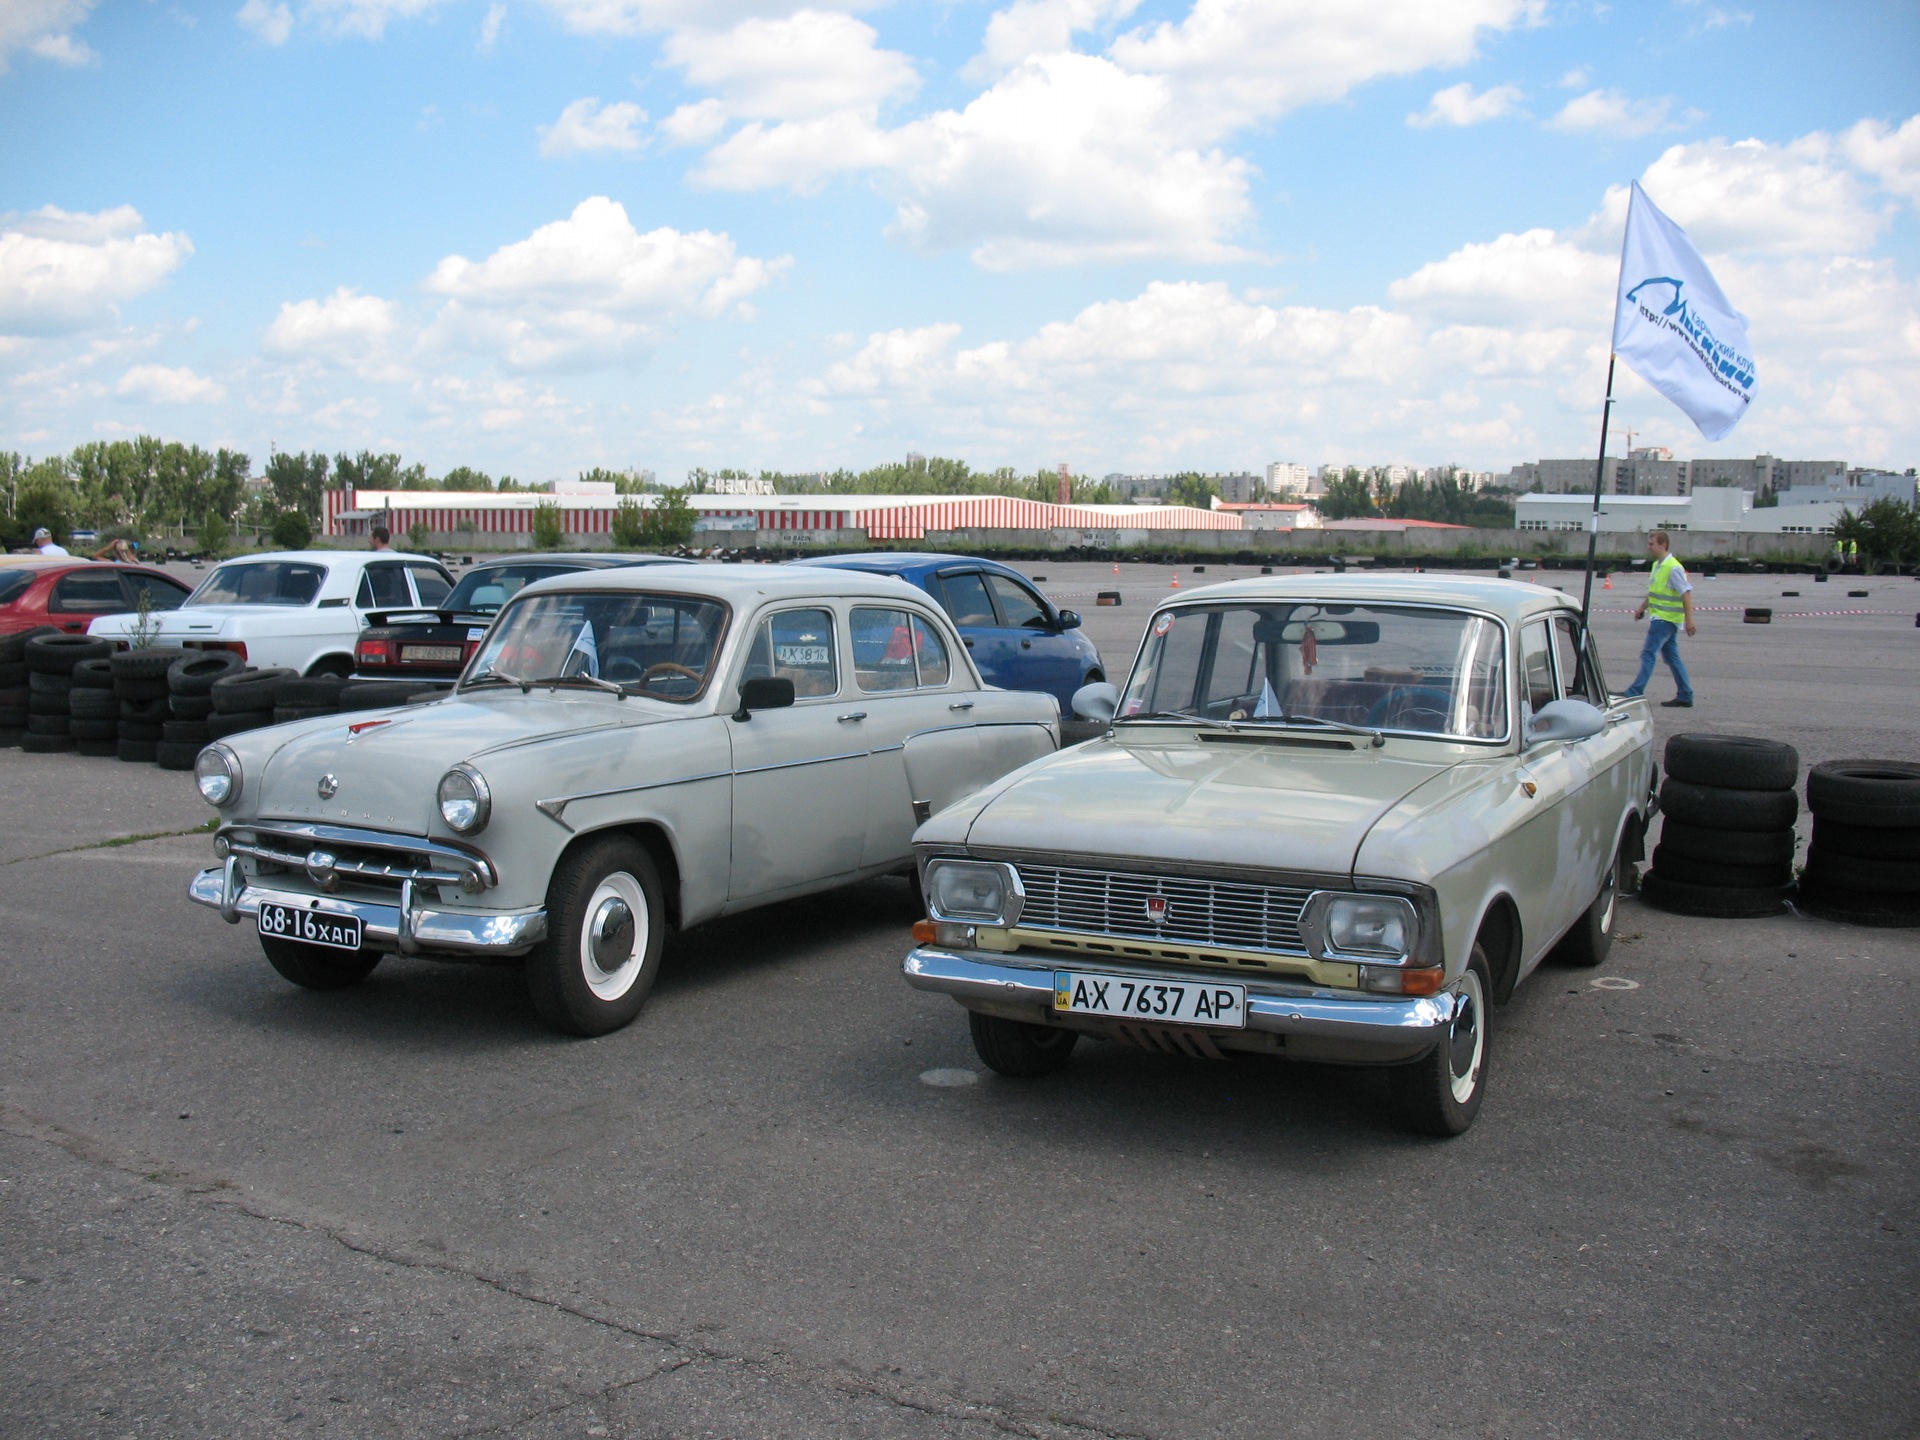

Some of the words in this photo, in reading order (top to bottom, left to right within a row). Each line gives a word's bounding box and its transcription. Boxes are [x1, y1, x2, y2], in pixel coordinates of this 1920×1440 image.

[1056, 996, 1068, 1006] UA
[1072, 979, 1110, 1011] AX
[1120, 983, 1185, 1016] 7637
[1194, 989, 1235, 1019] AP
